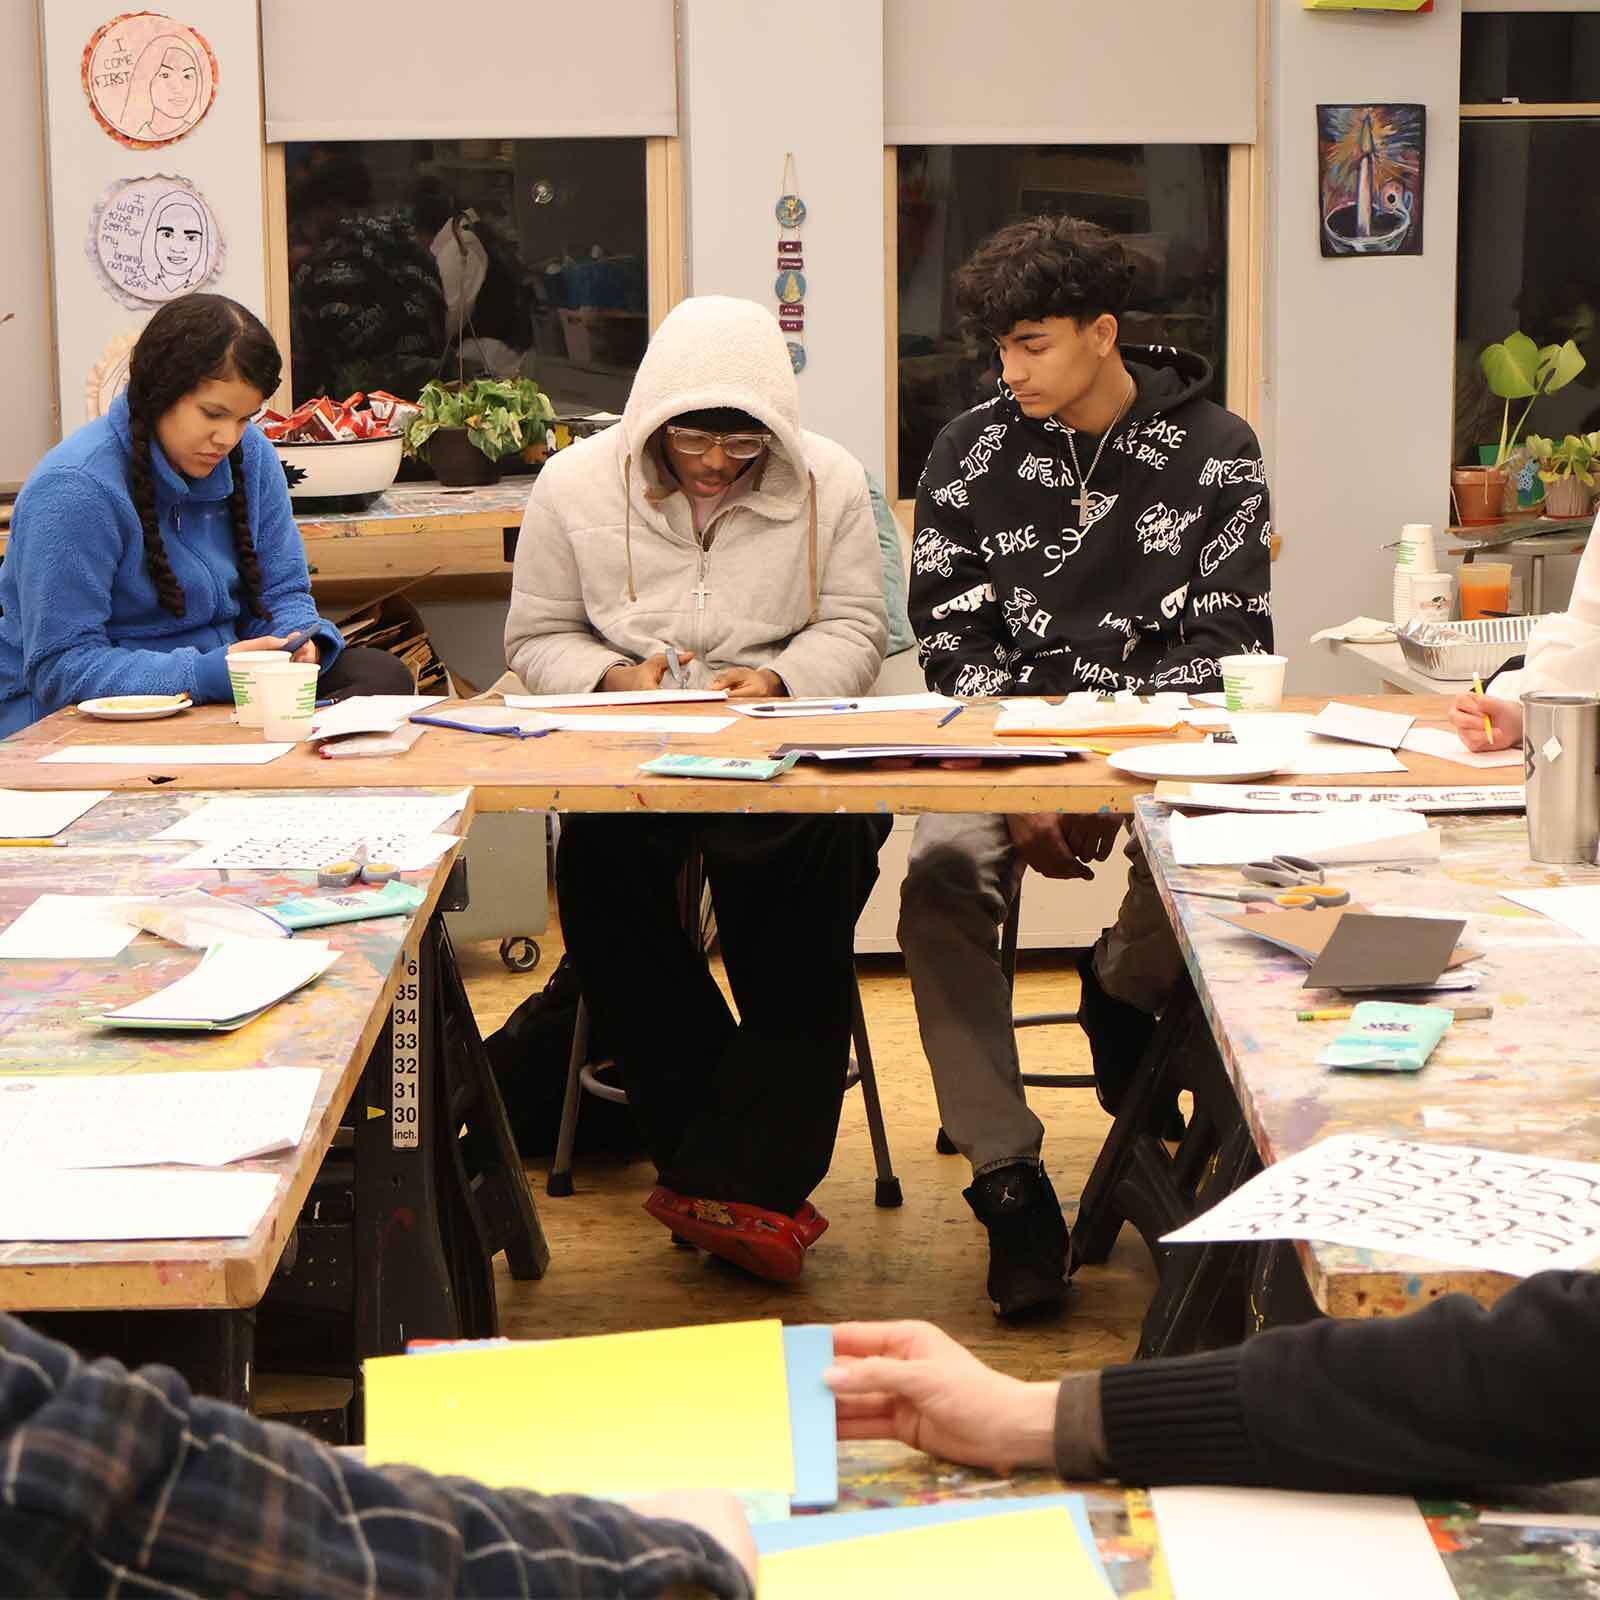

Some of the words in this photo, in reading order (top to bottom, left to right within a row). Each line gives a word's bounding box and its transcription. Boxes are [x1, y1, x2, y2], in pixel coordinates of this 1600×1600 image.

[112, 38, 126, 53] I
[104, 54, 134, 70] COME
[95, 71, 130, 88] FIRST
[1135, 444, 1169, 471] BASE
[995, 523, 1040, 556] BASE
[1072, 656, 1119, 689] MARS
[395, 983, 418, 1001] 35
[394, 1008, 417, 1025] 34
[394, 1032, 417, 1050] 33
[394, 1057, 417, 1074] 32
[394, 1082, 416, 1099] 31
[394, 1106, 417, 1124] 30
[394, 1129, 417, 1140] inch.
